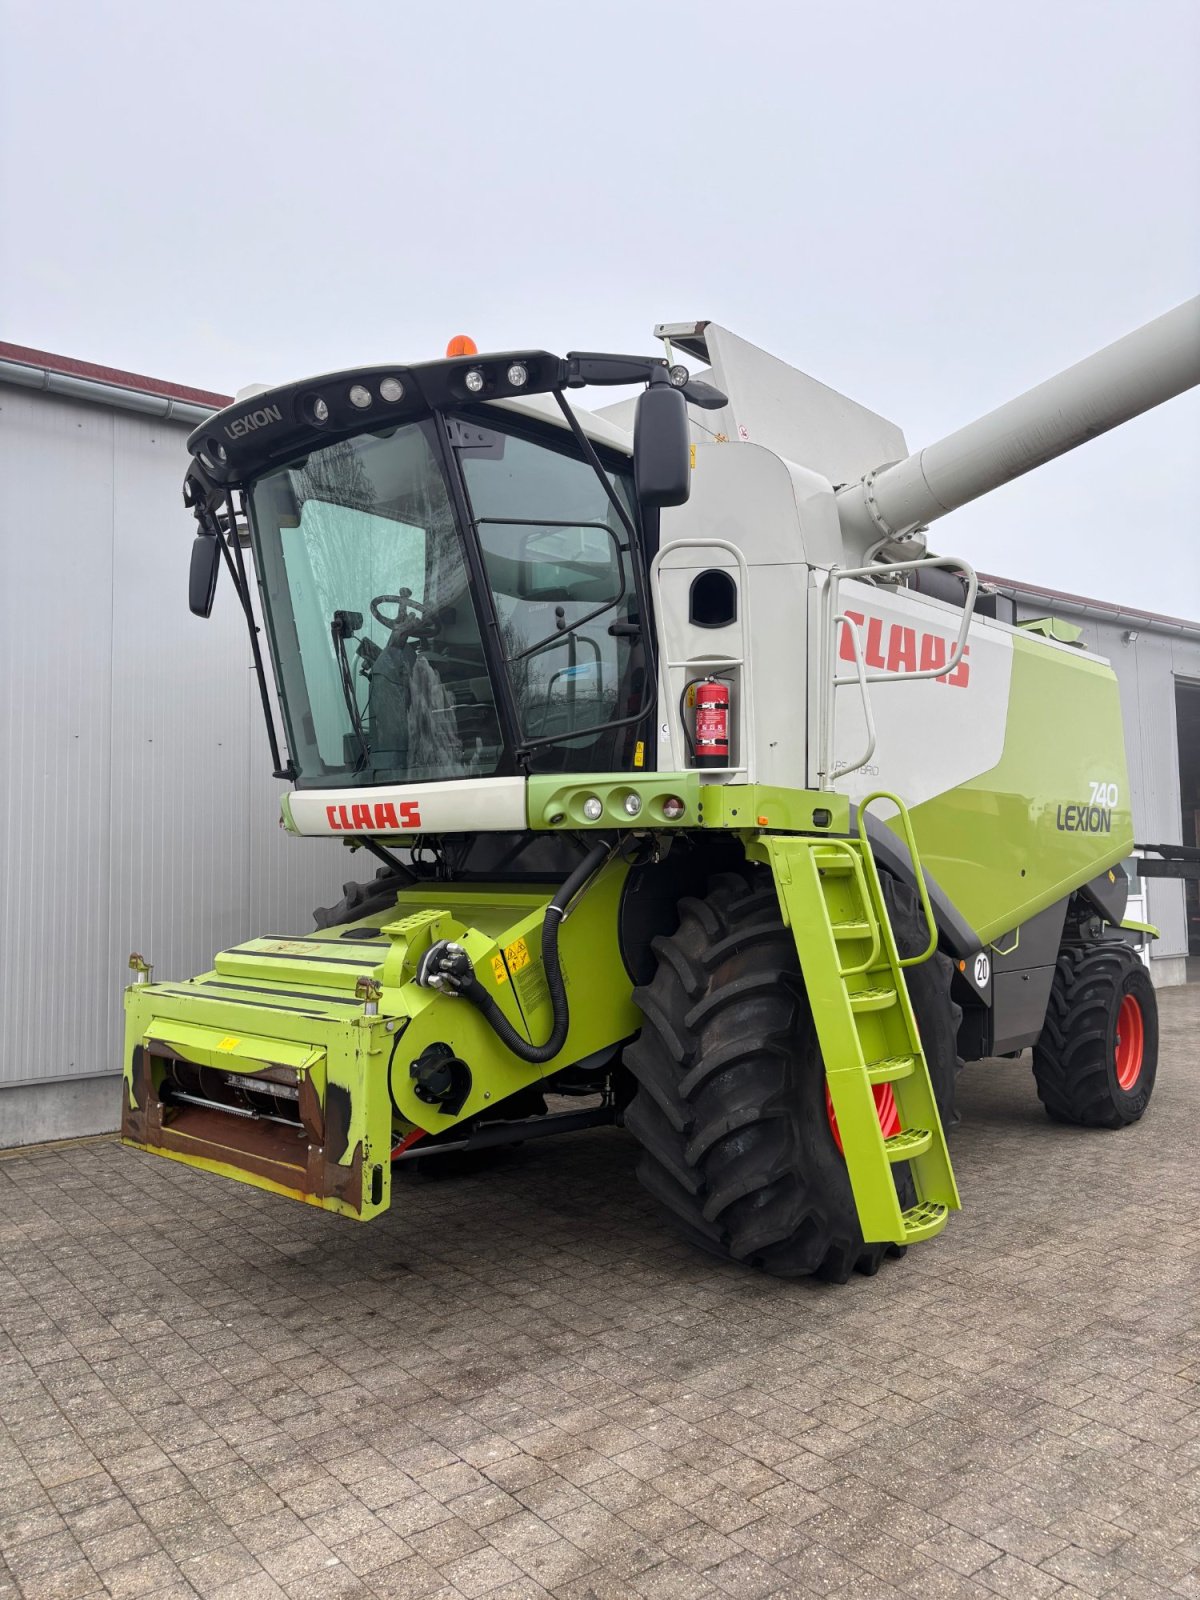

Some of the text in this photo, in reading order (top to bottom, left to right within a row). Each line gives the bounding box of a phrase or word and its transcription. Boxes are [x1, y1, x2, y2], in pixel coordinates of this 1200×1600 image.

[223, 404, 283, 440] LEXION
[839, 609, 970, 688] CLAAS
[1088, 781, 1119, 808] 740
[326, 801, 421, 830] CLAAS
[1056, 804, 1112, 833] LEXION
[976, 957, 988, 981] 20
